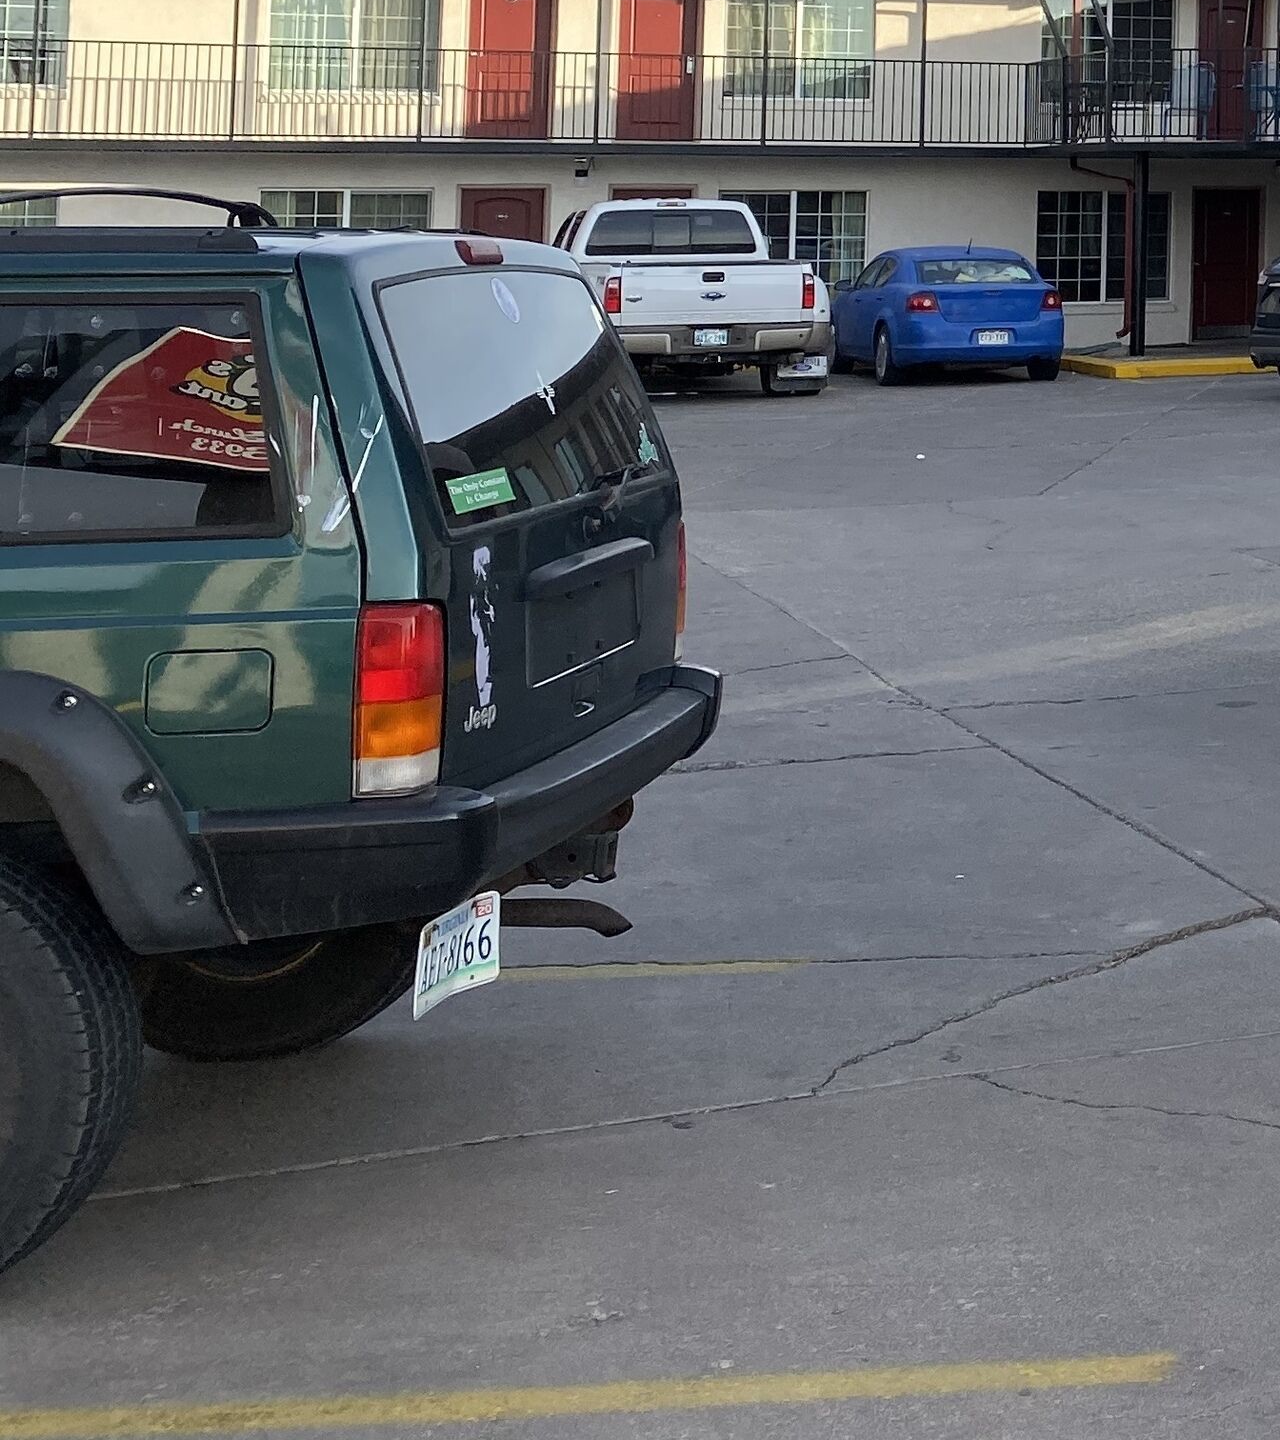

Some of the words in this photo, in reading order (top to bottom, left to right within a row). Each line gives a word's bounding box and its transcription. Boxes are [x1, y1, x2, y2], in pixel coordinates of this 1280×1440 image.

[450, 486, 463, 495] The
[463, 704, 498, 733] Jeep
[477, 904, 492, 916] 20
